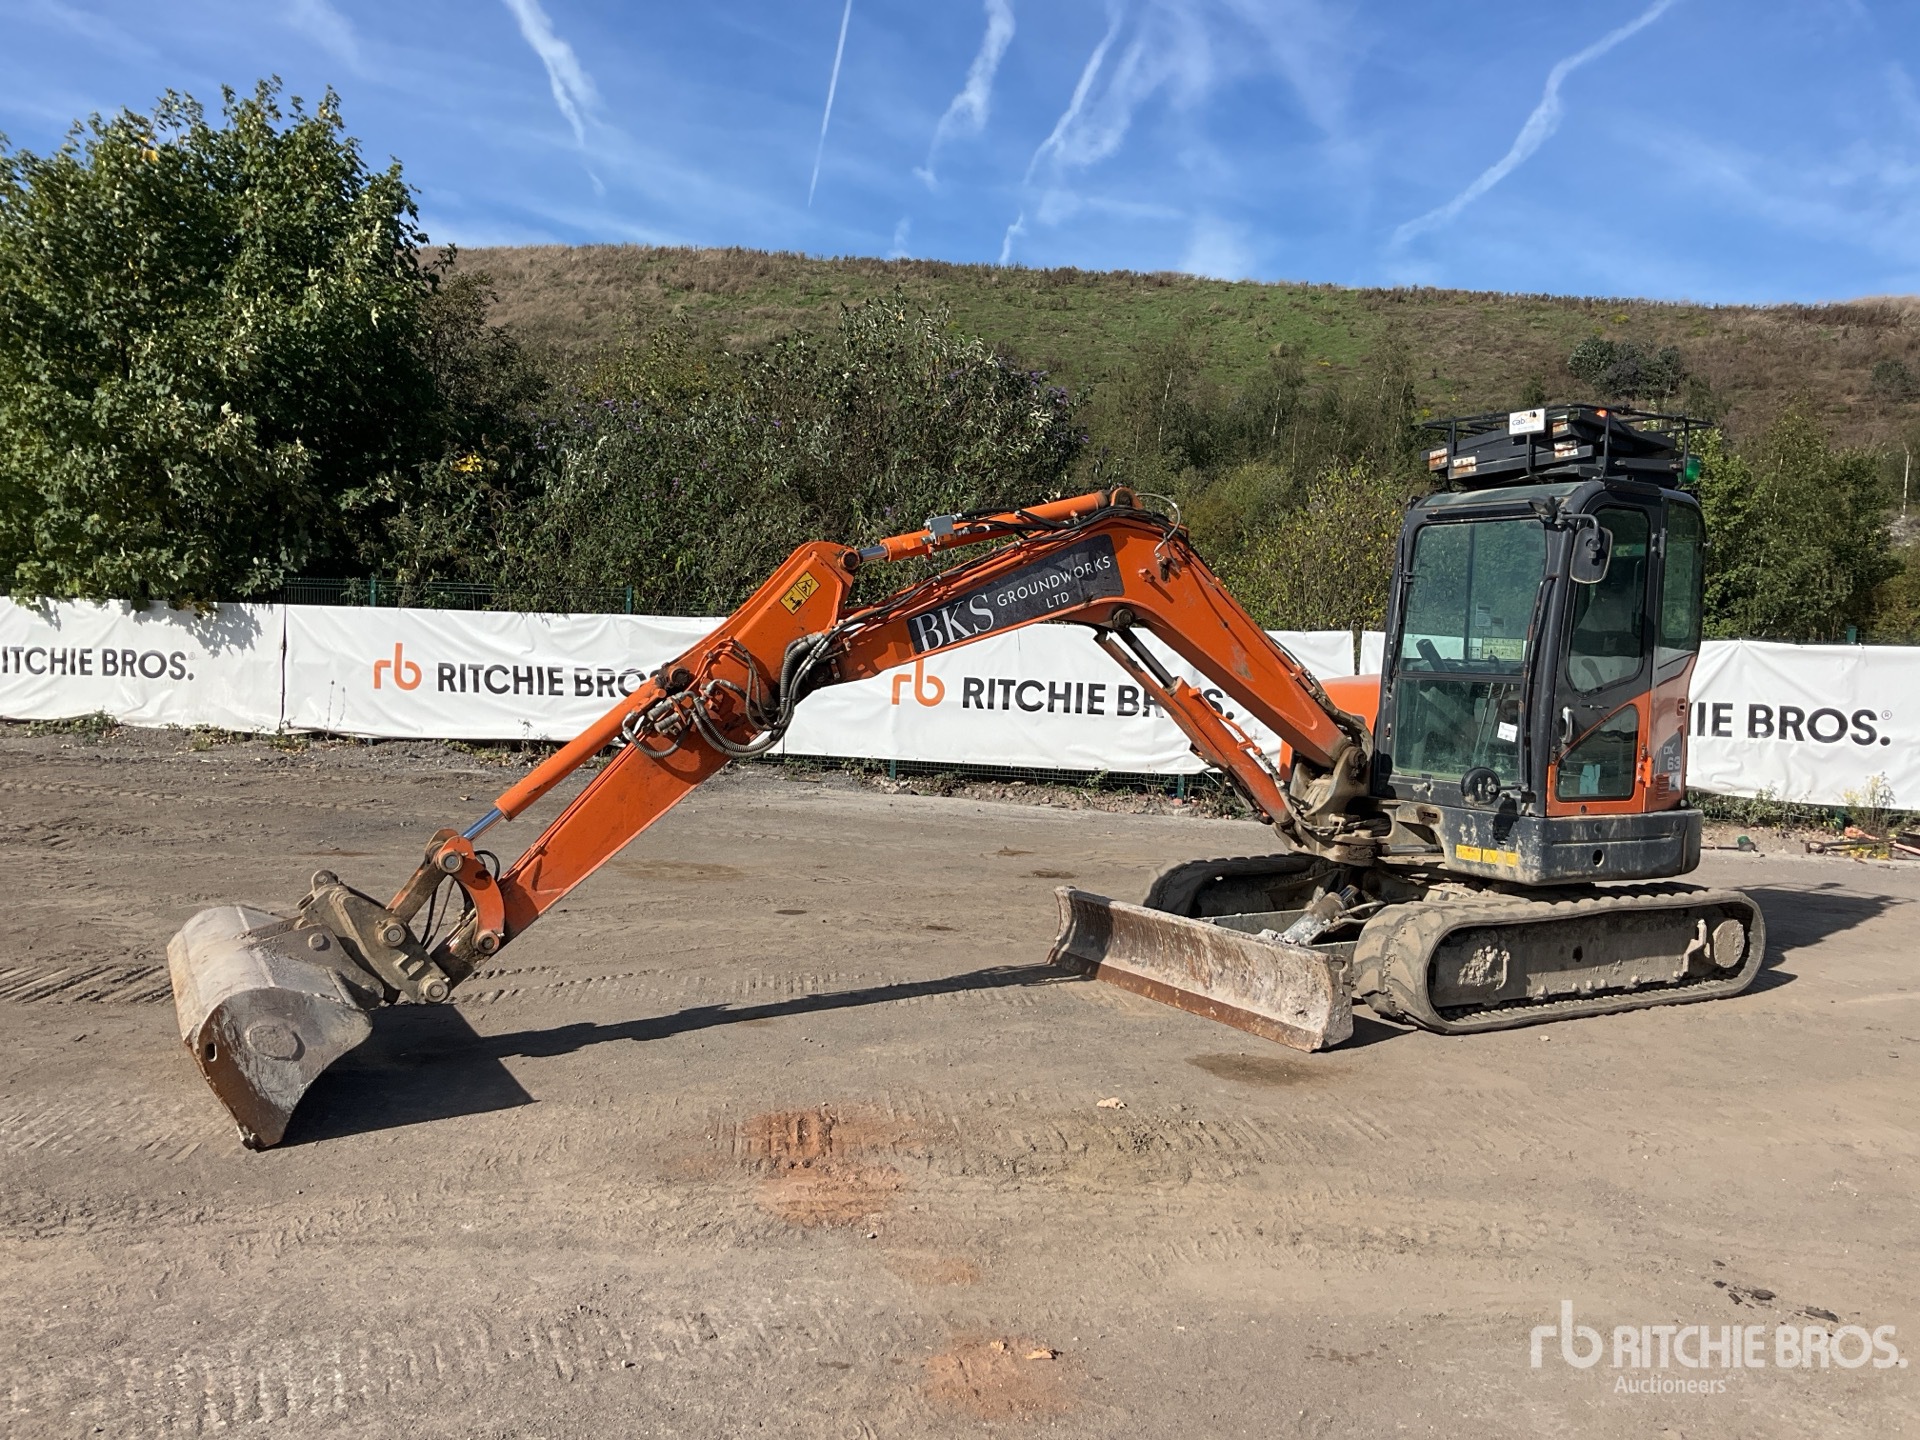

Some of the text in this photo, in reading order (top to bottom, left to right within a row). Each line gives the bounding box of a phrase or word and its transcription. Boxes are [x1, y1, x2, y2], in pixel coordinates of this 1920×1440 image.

[911, 555, 1112, 652] BKS GROUNDWORKS
[1046, 591, 1070, 609] LTD
[437, 662, 564, 696] RITCHIE
[574, 667, 661, 698] BRO
[963, 676, 1106, 716] RITCHIE
[1117, 684, 1234, 720] BRS.
[1687, 702, 1734, 738] IE
[1667, 756, 1681, 770] 63
